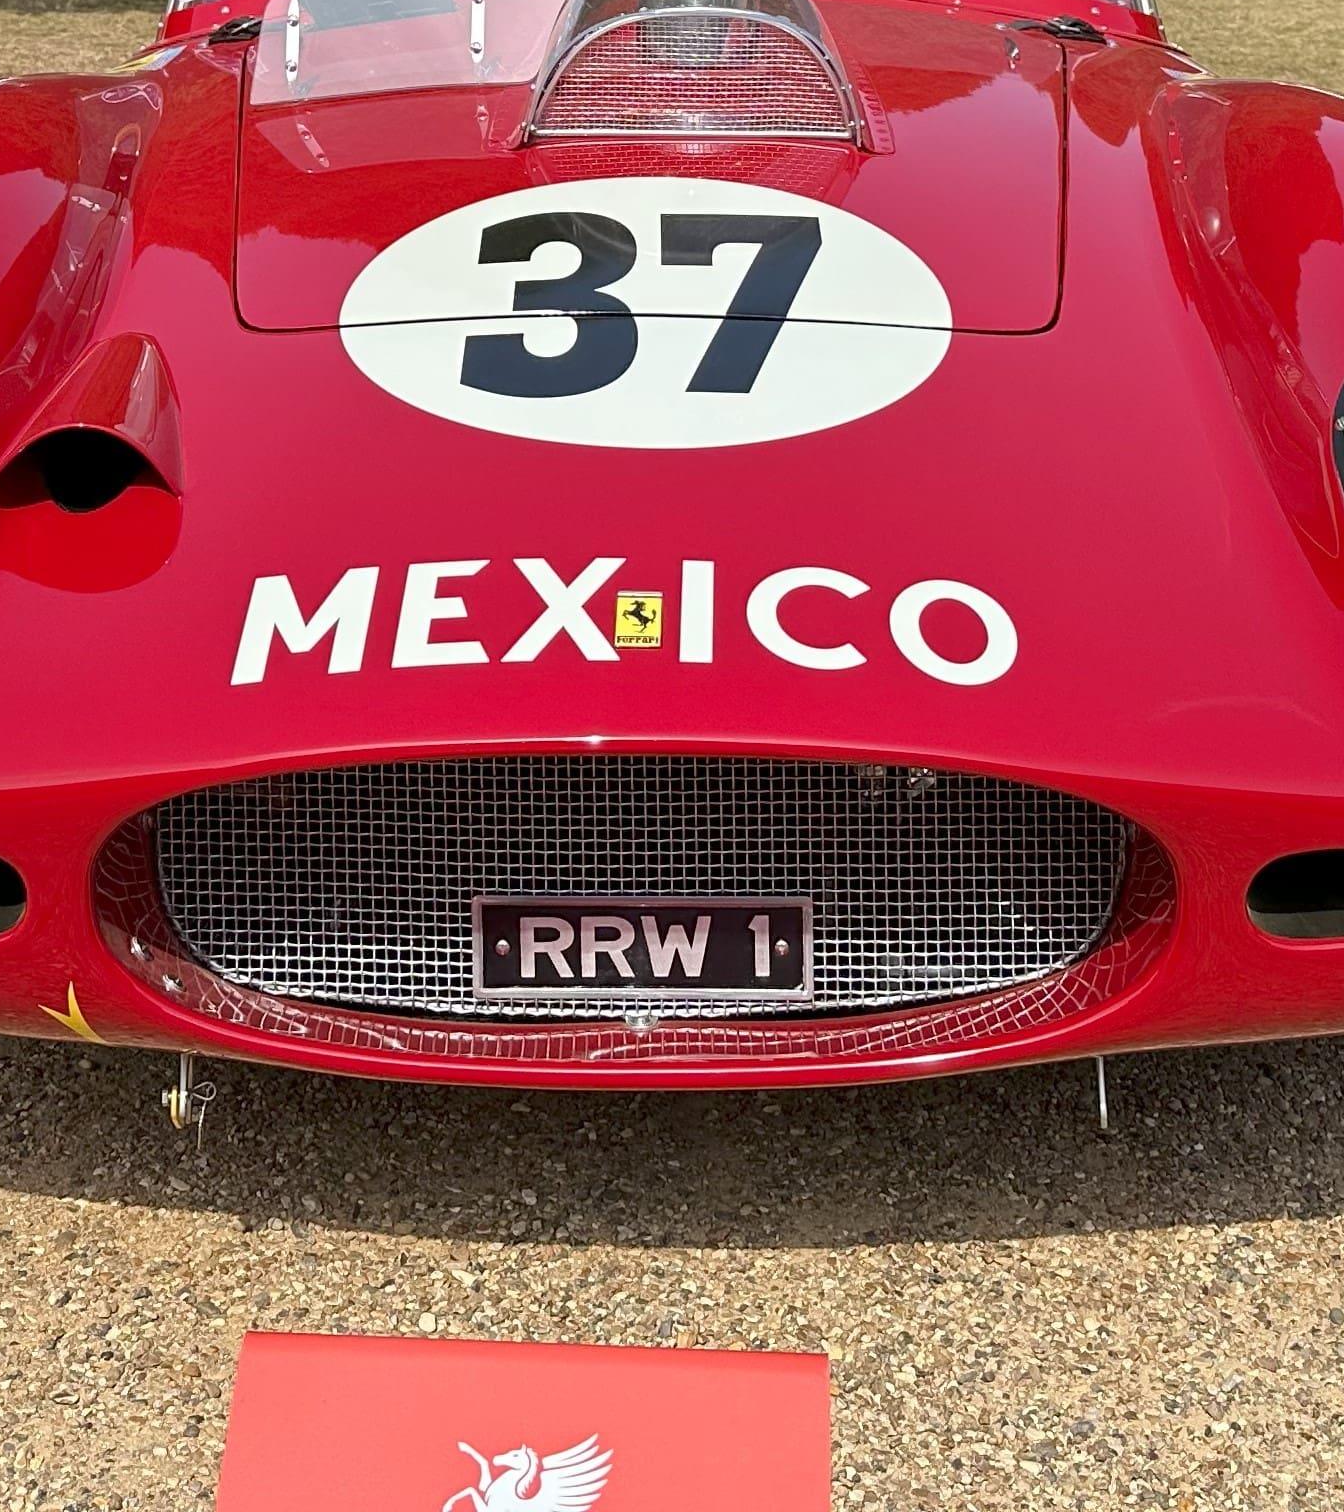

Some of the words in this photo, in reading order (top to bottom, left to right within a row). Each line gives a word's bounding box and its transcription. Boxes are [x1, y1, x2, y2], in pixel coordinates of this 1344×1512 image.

[460, 212, 822, 398] 37
[231, 558, 1019, 686] MEXICO
[616, 635, 659, 644] Ferrari
[520, 916, 712, 978] RRW
[748, 915, 771, 978] 1
